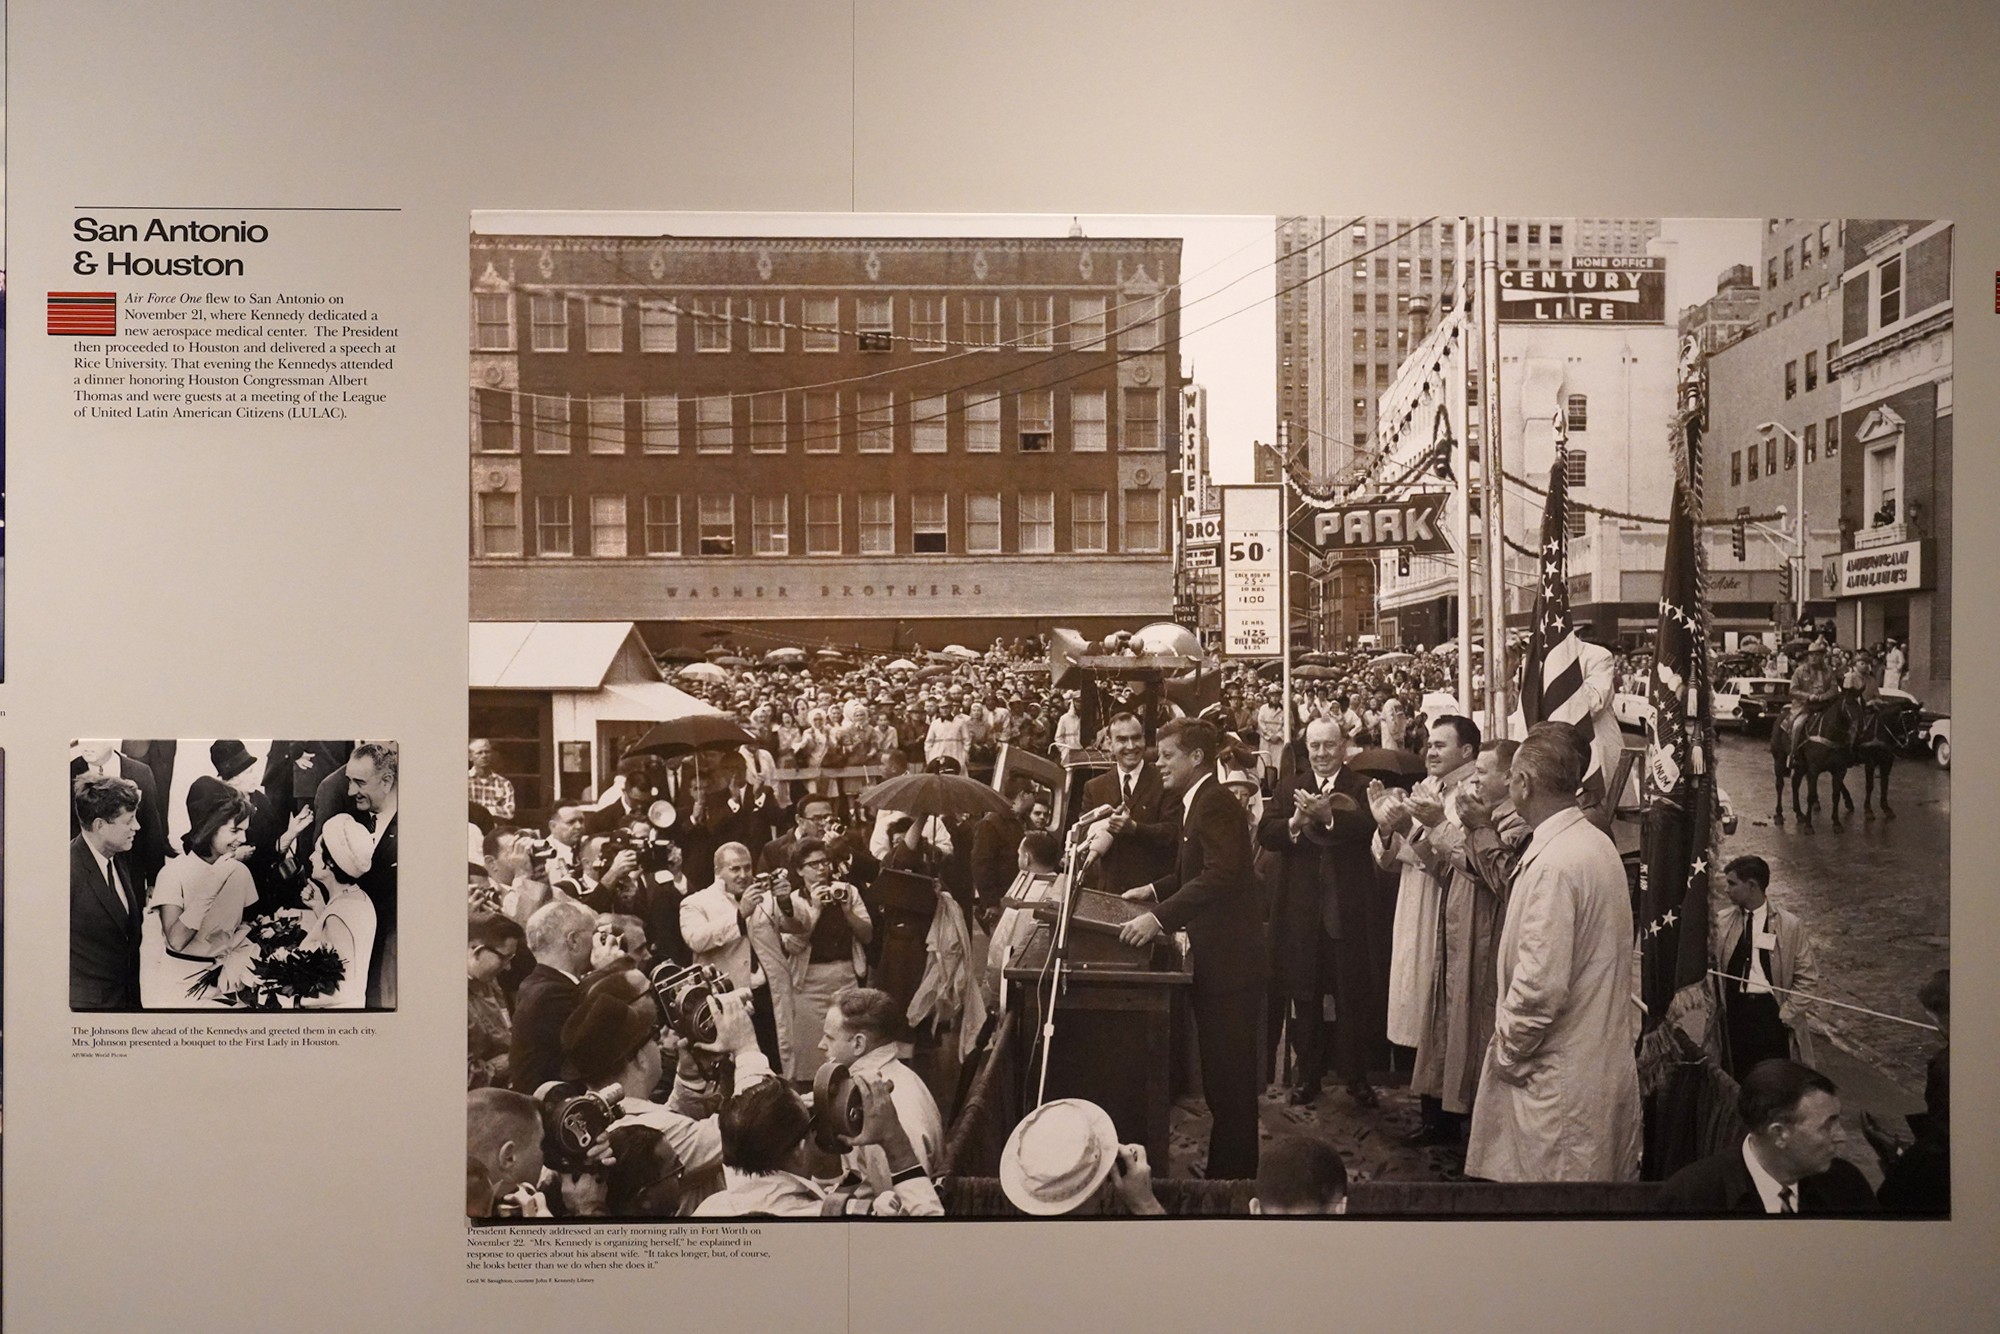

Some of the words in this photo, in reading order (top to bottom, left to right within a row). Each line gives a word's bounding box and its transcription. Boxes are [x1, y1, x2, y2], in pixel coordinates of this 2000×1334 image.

[74, 217, 137, 242] San
[144, 219, 268, 243] Antonio
[73, 251, 98, 275] &
[108, 252, 243, 276] Houston
[1576, 258, 1608, 268] HOME
[1612, 258, 1654, 268] OFFICE
[1500, 272, 1642, 288] CENTURY
[124, 292, 144, 303] Air
[147, 292, 176, 304] Force
[180, 293, 202, 304] One
[206, 292, 230, 304] flew
[234, 295, 246, 304] to
[249, 293, 271, 304] San
[276, 293, 325, 304] Antonio
[328, 296, 344, 304] on
[125, 309, 187, 320] November
[191, 309, 207, 322] 21,
[210, 309, 247, 320] where
[251, 309, 305, 323] Kennedy
[308, 309, 367, 321] dedicated
[1535, 303, 1614, 320] LIFE
[125, 328, 149, 336] new
[152, 328, 212, 340] aerospace
[216, 325, 263, 336] medical
[267, 328, 307, 337] center.
[314, 326, 338, 337] The
[342, 326, 398, 337] President
[74, 341, 101, 352] then
[105, 341, 169, 356] proceeded
[173, 344, 185, 352] to
[189, 342, 239, 353] Houston
[243, 342, 266, 353] and
[270, 342, 326, 353] delivered
[340, 342, 381, 356] speech
[385, 344, 396, 353] at
[74, 358, 101, 368] Rice
[105, 358, 167, 372] University.
[171, 358, 200, 369] That
[203, 358, 251, 372] evening
[254, 358, 274, 369] the
[278, 358, 337, 372] Kennedys
[340, 358, 393, 370] attended
[84, 374, 125, 385] dinner
[129, 374, 185, 388] honoring
[188, 374, 239, 385] Houston
[243, 374, 324, 388] Congressman
[328, 374, 368, 386] Albert
[73, 390, 123, 401] Thomas
[126, 390, 149, 401] and
[185, 393, 222, 405] guests
[225, 393, 237, 402] at
[251, 390, 300, 405] meeting
[303, 390, 318, 402] of
[319, 391, 339, 402] the
[342, 391, 386, 405] League
[74, 406, 88, 417] of
[91, 406, 132, 418] United
[136, 407, 168, 418] Latin
[172, 407, 232, 418] American
[236, 407, 284, 418] Citizens
[288, 407, 347, 420] (LULAC).
[1184, 392, 1196, 512] WASHER
[1186, 521, 1221, 538] BROS
[1314, 508, 1434, 546] PARK
[667, 587, 788, 598] WASHER
[821, 585, 982, 598] BROTHERS
[71, 1026, 89, 1035] The
[90, 1026, 129, 1037] Johnsons
[131, 1026, 149, 1035] flew
[151, 1027, 177, 1035] ahead
[179, 1027, 189, 1035] of
[190, 1026, 204, 1035] the
[206, 1027, 248, 1037] Kennedys
[250, 1027, 266, 1035] and
[268, 1026, 300, 1037] greeted
[303, 1026, 325, 1035] them
[328, 1026, 336, 1035] in
[338, 1026, 358, 1035] each
[360, 1026, 377, 1037] city.
[91, 1038, 127, 1049] Johnson
[129, 1038, 171, 1049] presented
[181, 1038, 216, 1049] bouquet
[229, 1038, 243, 1046] the
[246, 1038, 264, 1046] First
[267, 1038, 289, 1048] Lady
[291, 1038, 299, 1046] in
[302, 1038, 340, 1046] Houston.
[467, 1227, 506, 1235] President
[509, 1227, 547, 1237] Kennedy
[549, 1227, 591, 1235] addressed
[606, 1227, 628, 1237] early
[630, 1227, 667, 1237] morning
[669, 1227, 688, 1237] rally
[690, 1227, 698, 1235] in
[701, 1227, 718, 1235] Fort
[721, 1227, 748, 1235] Worth
[467, 1238, 511, 1247] November
[555, 1238, 593, 1248] Kennedy
[603, 1238, 648, 1248] organizing
[687, 1238, 698, 1246] he
[699, 1238, 741, 1249] explained
[743, 1238, 752, 1246] in
[467, 1252, 504, 1260] response
[516, 1250, 548, 1260] queries
[550, 1250, 574, 1258] about
[576, 1250, 589, 1258] his
[590, 1250, 618, 1258] absent
[620, 1250, 640, 1258] wife.
[657, 1250, 679, 1258] takes
[681, 1250, 710, 1260] longer,
[712, 1250, 728, 1258] but,
[466, 1261, 481, 1270] she
[483, 1261, 505, 1269] looks
[507, 1261, 532, 1269] better
[535, 1261, 554, 1269] than
[570, 1261, 582, 1269] do
[584, 1261, 607, 1269] when
[609, 1261, 623, 1269] she
[625, 1261, 645, 1269] does
